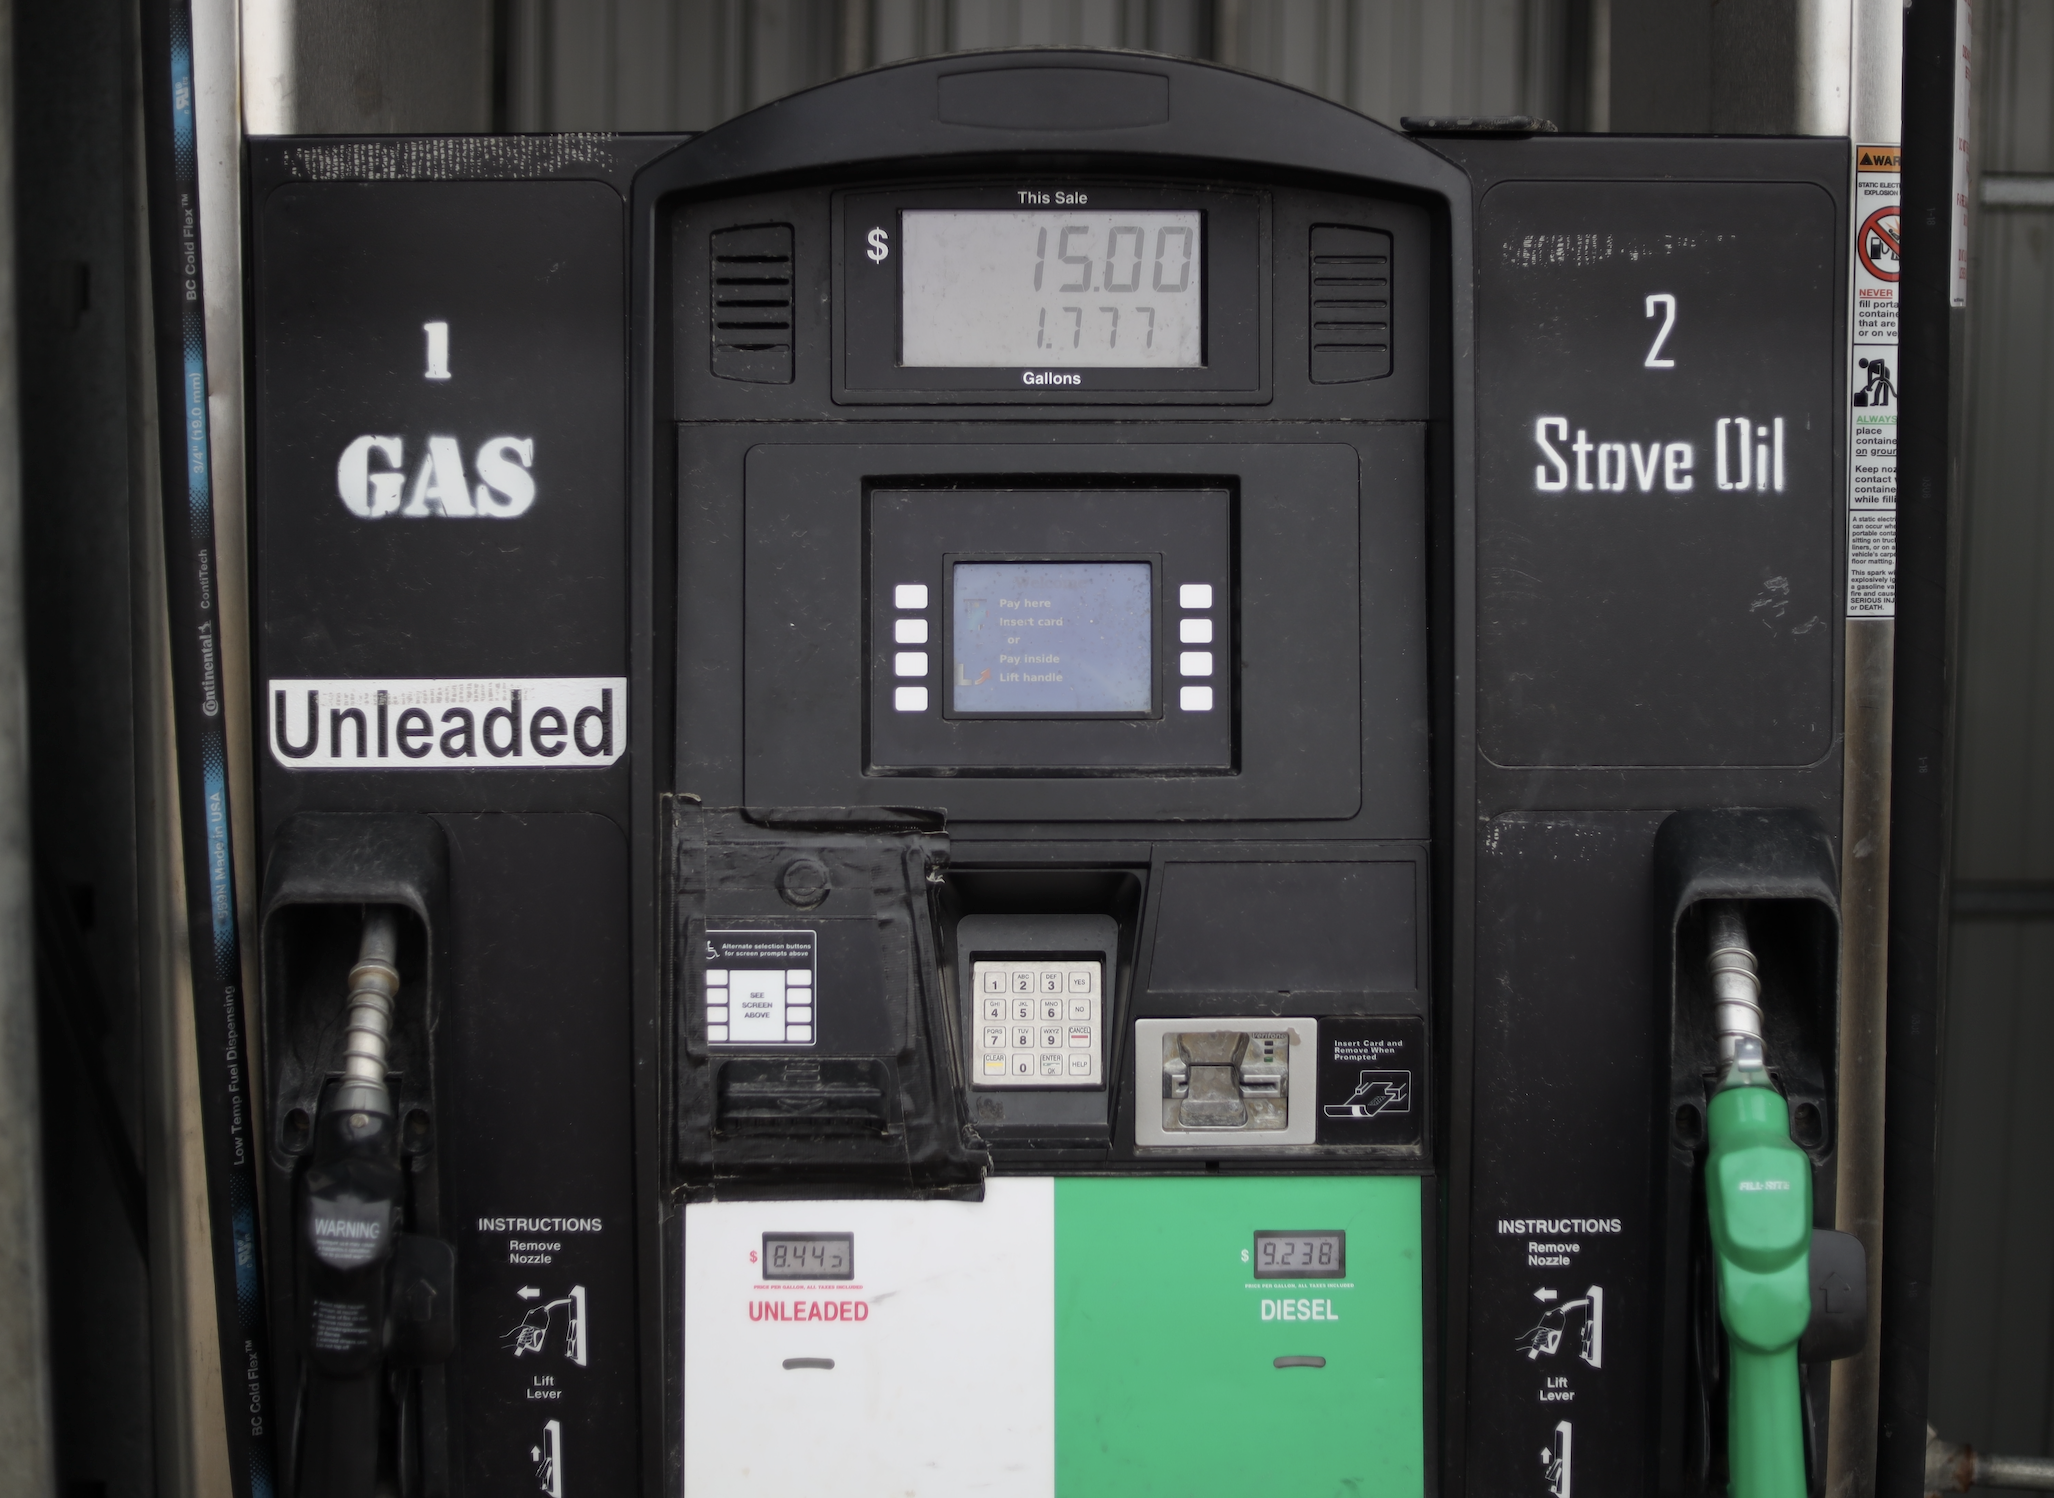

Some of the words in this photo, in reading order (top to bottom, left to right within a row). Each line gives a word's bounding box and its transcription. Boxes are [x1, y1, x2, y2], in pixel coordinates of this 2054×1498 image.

[1017, 191, 1051, 204] This
[1055, 191, 1088, 204] Sale
[867, 227, 889, 264] $
[184, 241, 196, 275] Cold
[1033, 226, 1194, 293] 15.00
[186, 279, 197, 301] BC
[1859, 289, 1893, 297] NEVER
[1859, 300, 1871, 308] fill
[1037, 307, 1156, 349] 1.777
[1858, 319, 1878, 327] that
[1644, 293, 1676, 368] 2
[423, 321, 452, 379] 1
[1023, 372, 1082, 385] Gallons
[189, 372, 202, 404] mm)
[191, 407, 203, 441] (19.0
[1856, 415, 1897, 423] ALWAYS
[1856, 427, 1882, 436] place
[1536, 416, 1693, 491] Stove
[1716, 416, 1784, 491] Oil
[1855, 465, 1879, 474] Keep
[337, 434, 536, 519] GAS
[1854, 495, 1880, 503] while
[198, 549, 211, 610] ContiTech
[1867, 569, 1886, 577] spark
[1000, 599, 1021, 610] Pay
[1024, 598, 1051, 608] here
[1000, 617, 1034, 626] Insert
[1038, 617, 1063, 626] card
[1008, 636, 1020, 644] or
[1000, 654, 1021, 665] Pay
[1024, 653, 1060, 663] inside
[198, 632, 219, 717] Continental
[1000, 672, 1020, 682] Lift
[1023, 672, 1063, 682] handle
[274, 688, 614, 759] Unleaded
[210, 792, 223, 823] USA
[212, 826, 224, 840] in
[214, 842, 227, 881] Made
[992, 981, 997, 990] 1
[1019, 981, 1027, 990] 2
[1047, 981, 1055, 990] 3
[991, 1008, 998, 1018] 4
[1019, 1008, 1027, 1018] 5
[1047, 1008, 1055, 1018] 6
[223, 985, 239, 1061] Dispensing
[991, 1036, 998, 1045] 7
[1019, 1036, 1027, 1045] 8
[1047, 1036, 1055, 1045] 9
[1019, 1063, 1027, 1072] 0
[227, 1063, 240, 1093] Fuel
[230, 1095, 243, 1134] Temp
[233, 1137, 245, 1166] Low
[315, 1218, 380, 1239] WARNING
[478, 1218, 602, 1231] INSTRUCTIONS
[1498, 1219, 1622, 1233] INSTRUCTIONS
[509, 1240, 561, 1251] Remove
[1528, 1242, 1580, 1253] Remove
[509, 1253, 552, 1264] Nozzle
[749, 1250, 758, 1264] $
[1241, 1249, 1249, 1263] $
[1263, 1242, 1332, 1265] 9.238
[1528, 1255, 1570, 1266] Nozzle
[749, 1301, 869, 1321] UNLEADED
[1261, 1299, 1339, 1320] DIESEL
[533, 1375, 555, 1386] Lift
[1547, 1377, 1568, 1388] Lift
[250, 1383, 262, 1414] Cold
[526, 1389, 562, 1399] Lever
[1539, 1390, 1575, 1401] Lever
[252, 1417, 263, 1436] BC
